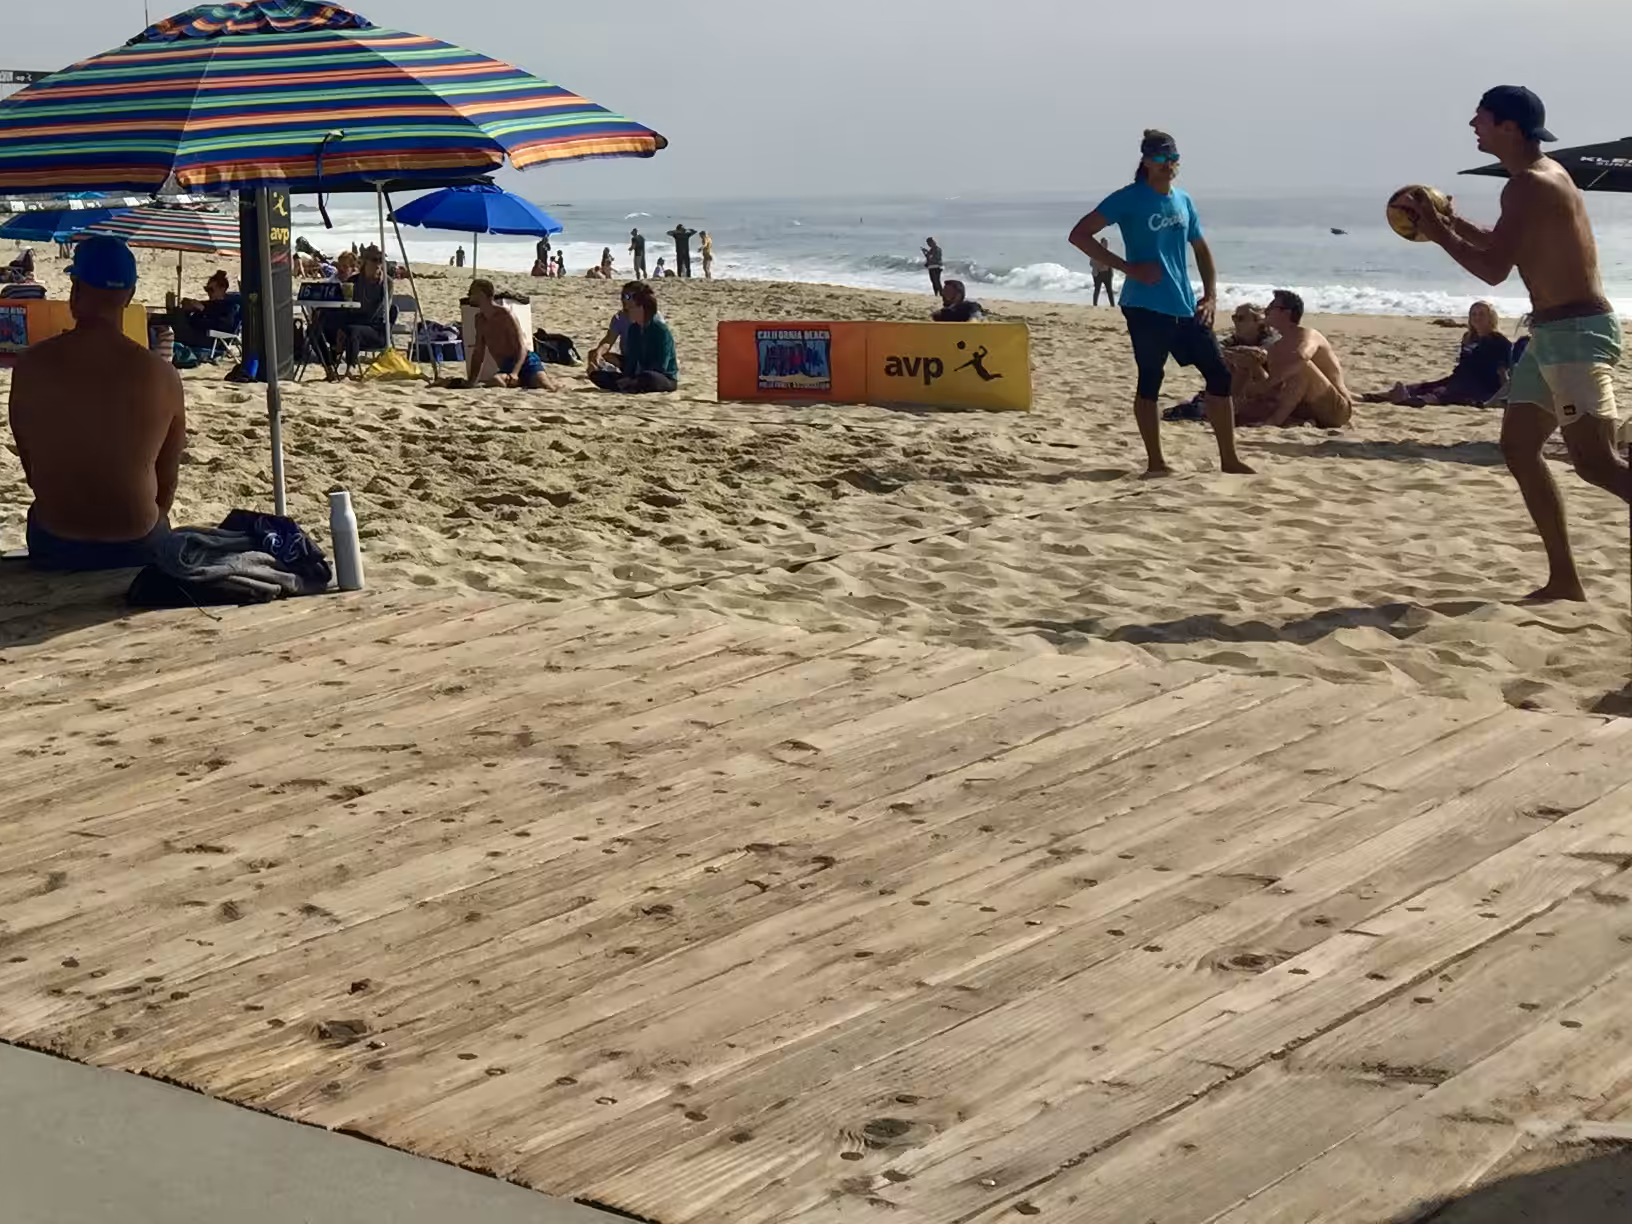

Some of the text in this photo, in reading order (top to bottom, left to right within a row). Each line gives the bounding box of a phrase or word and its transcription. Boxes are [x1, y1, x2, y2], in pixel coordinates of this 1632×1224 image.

[270, 227, 289, 245] avp
[757, 330, 830, 340] CALIFORNIA BEACH
[884, 354, 944, 385] avp
